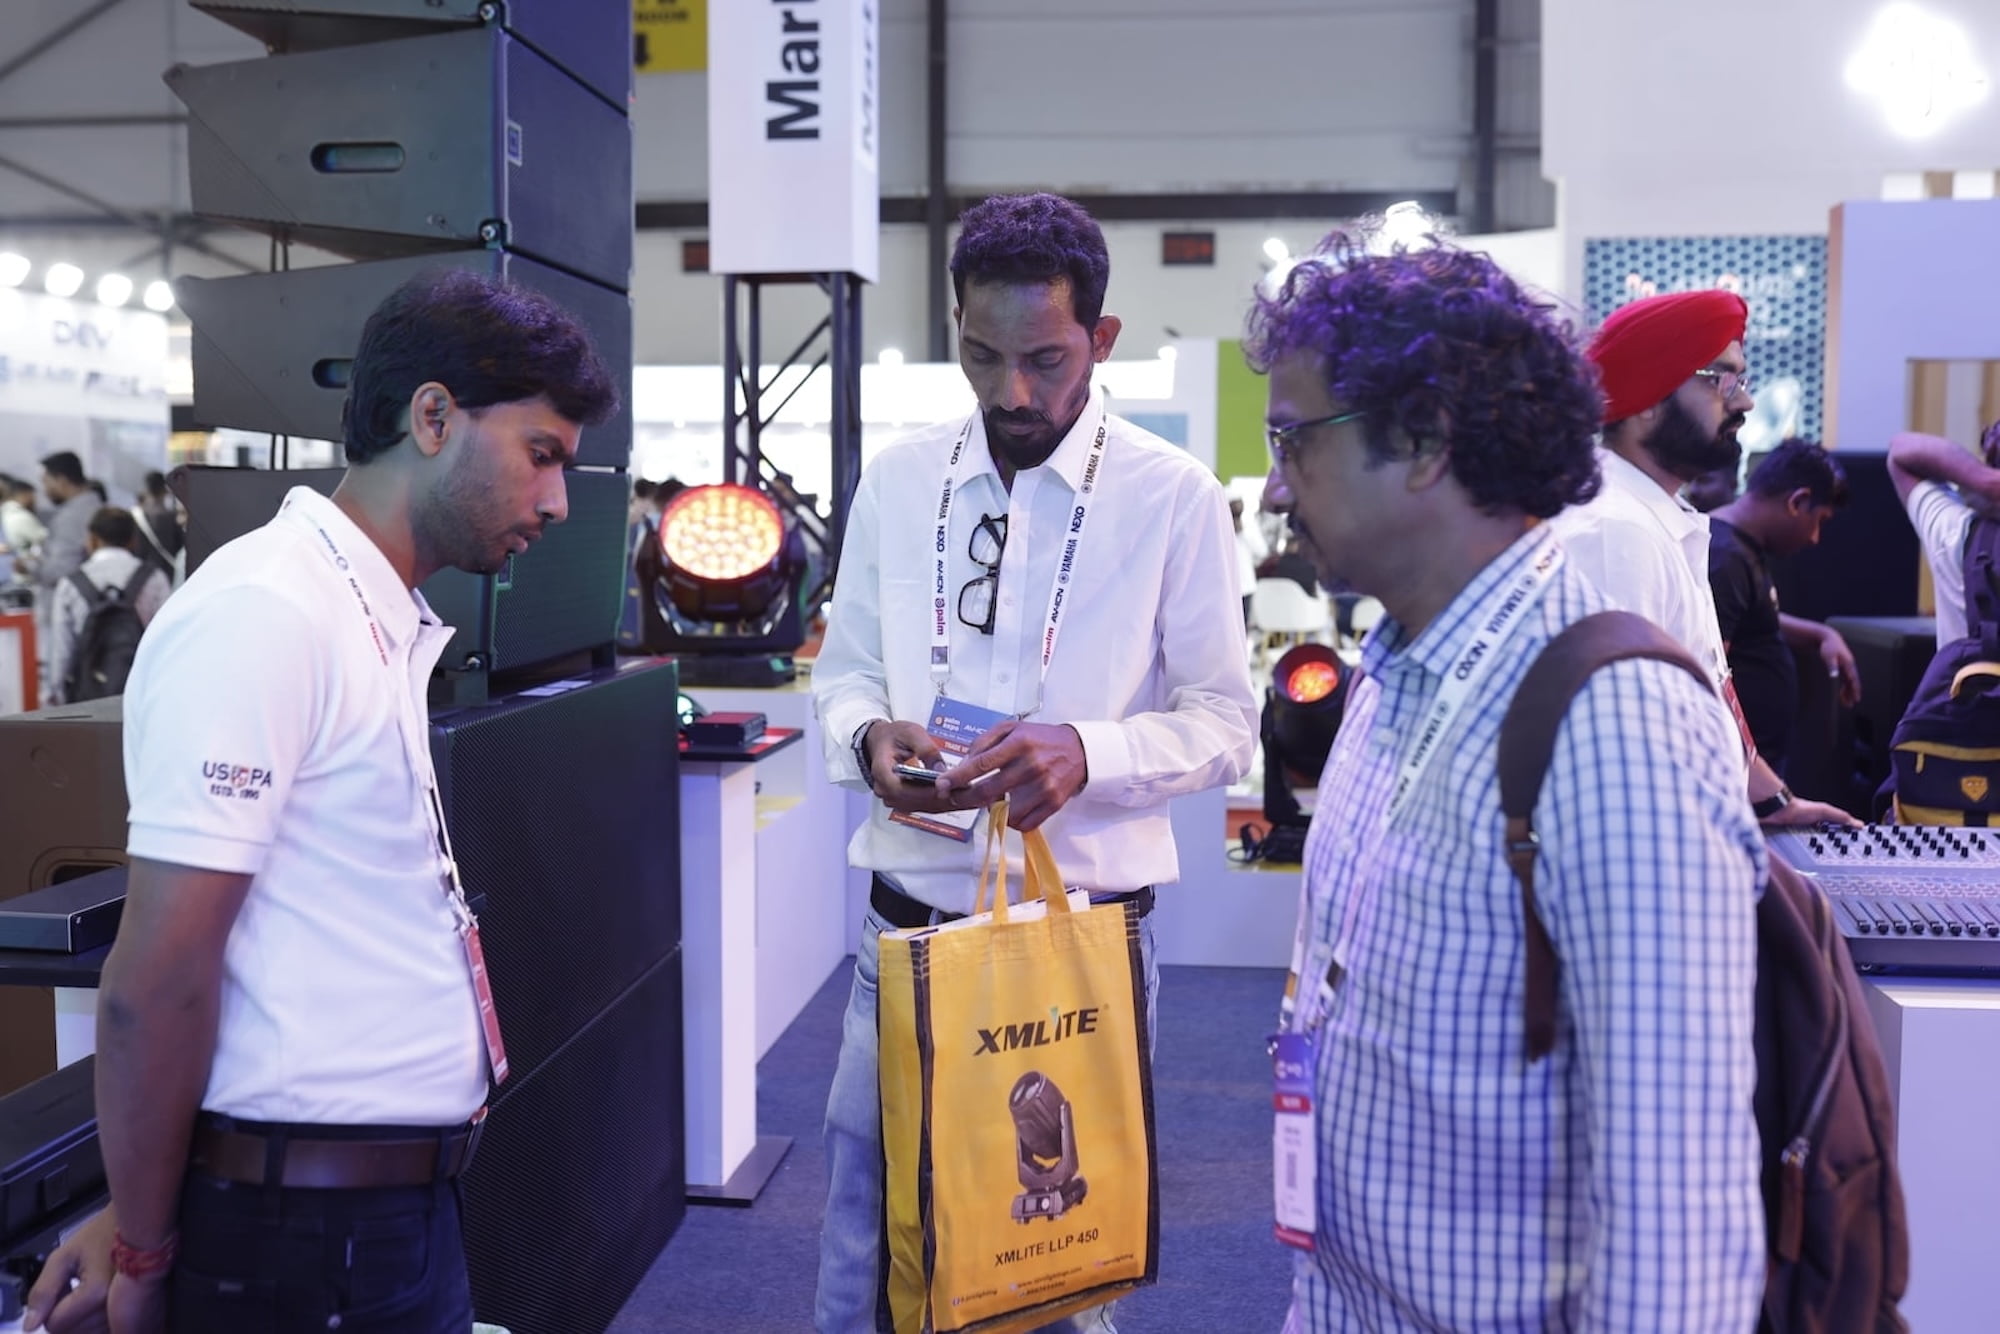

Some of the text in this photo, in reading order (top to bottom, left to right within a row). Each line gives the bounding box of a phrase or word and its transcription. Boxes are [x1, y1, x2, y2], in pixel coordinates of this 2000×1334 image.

[766, 0, 819, 140] Mar
[1083, 426, 1106, 484] YAMAHA NEXO
[938, 487, 953, 520] YAMAHA
[936, 525, 945, 553] NEXO
[1060, 539, 1078, 573] YAMAHA
[1070, 506, 1085, 533] NEXO
[936, 609, 947, 636] palm
[1455, 587, 1528, 681] YAMAHA NEXO
[973, 1007, 1099, 1055] XMLITE
[994, 1228, 1100, 1268] XMLITE LLP 450
